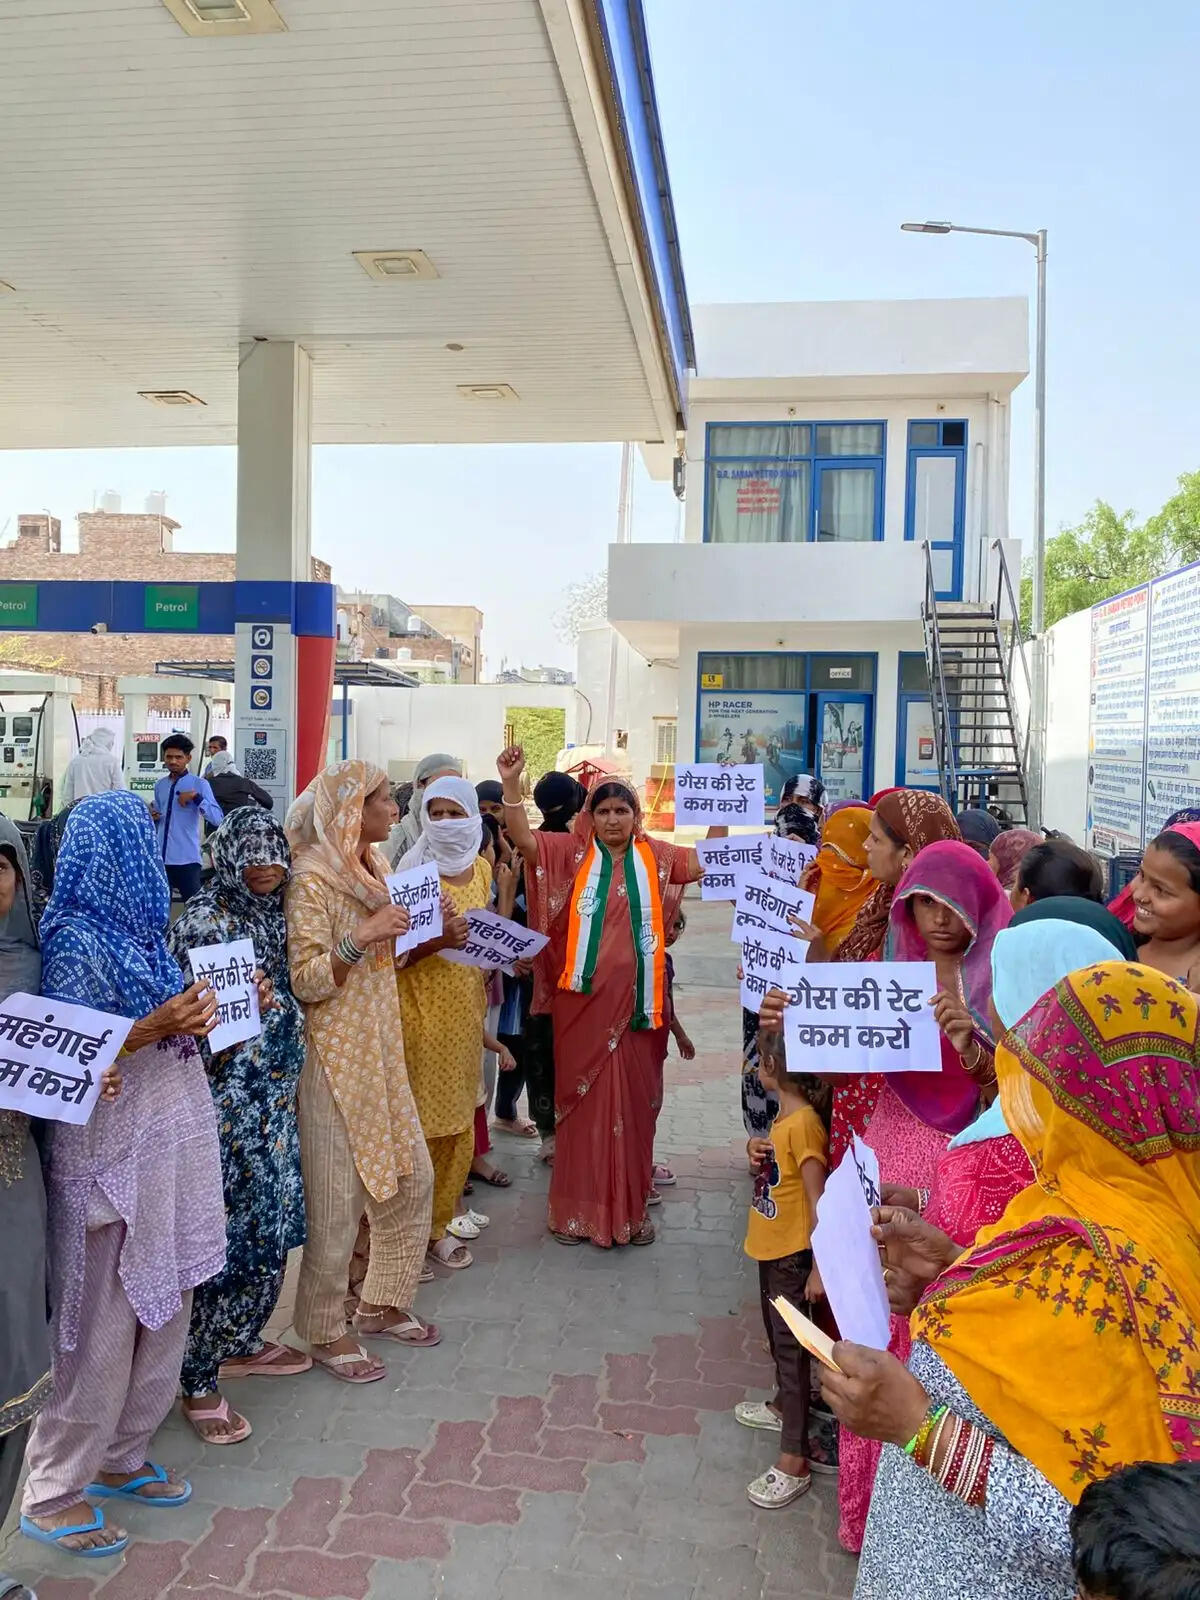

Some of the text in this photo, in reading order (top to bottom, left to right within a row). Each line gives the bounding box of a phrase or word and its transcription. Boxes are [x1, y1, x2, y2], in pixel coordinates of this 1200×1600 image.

[155, 602, 187, 612] Petrol
[132, 782, 154, 790] Petro
[678, 770, 756, 791] गैस की रेट
[683, 794, 749, 813] कम करो
[703, 841, 763, 866] महंगाई
[420, 876, 430, 900] की
[431, 876, 439, 898] रेट
[703, 873, 736, 888] कम
[419, 903, 434, 926] करो
[467, 917, 535, 953] महंगाई
[743, 936, 769, 970] पेट्रॉल
[770, 946, 785, 970] की
[225, 956, 240, 987] की
[241, 956, 253, 984] रेट
[746, 973, 767, 996] कम
[787, 976, 923, 1012] गैस की रेट
[216, 990, 251, 1023] म करो
[0, 1014, 113, 1066] महंगाई
[798, 1018, 911, 1050] कम करो
[27, 1069, 94, 1105] करो
